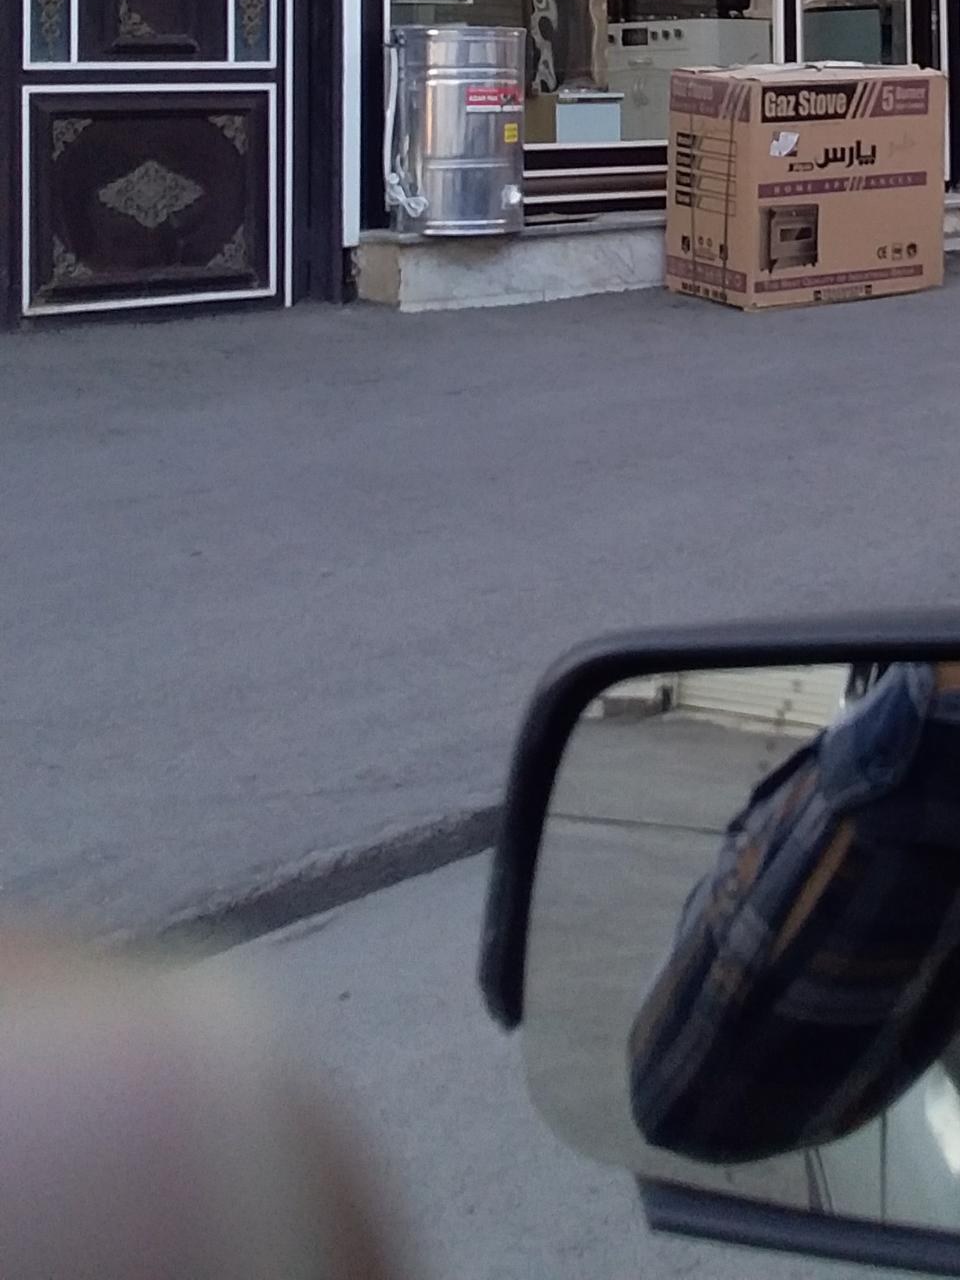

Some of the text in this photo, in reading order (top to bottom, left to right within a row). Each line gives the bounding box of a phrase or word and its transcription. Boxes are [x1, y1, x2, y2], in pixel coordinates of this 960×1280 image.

[764, 90, 847, 118] Gaz Stove
[882, 86, 895, 112] 5
[815, 140, 877, 169] پارس
